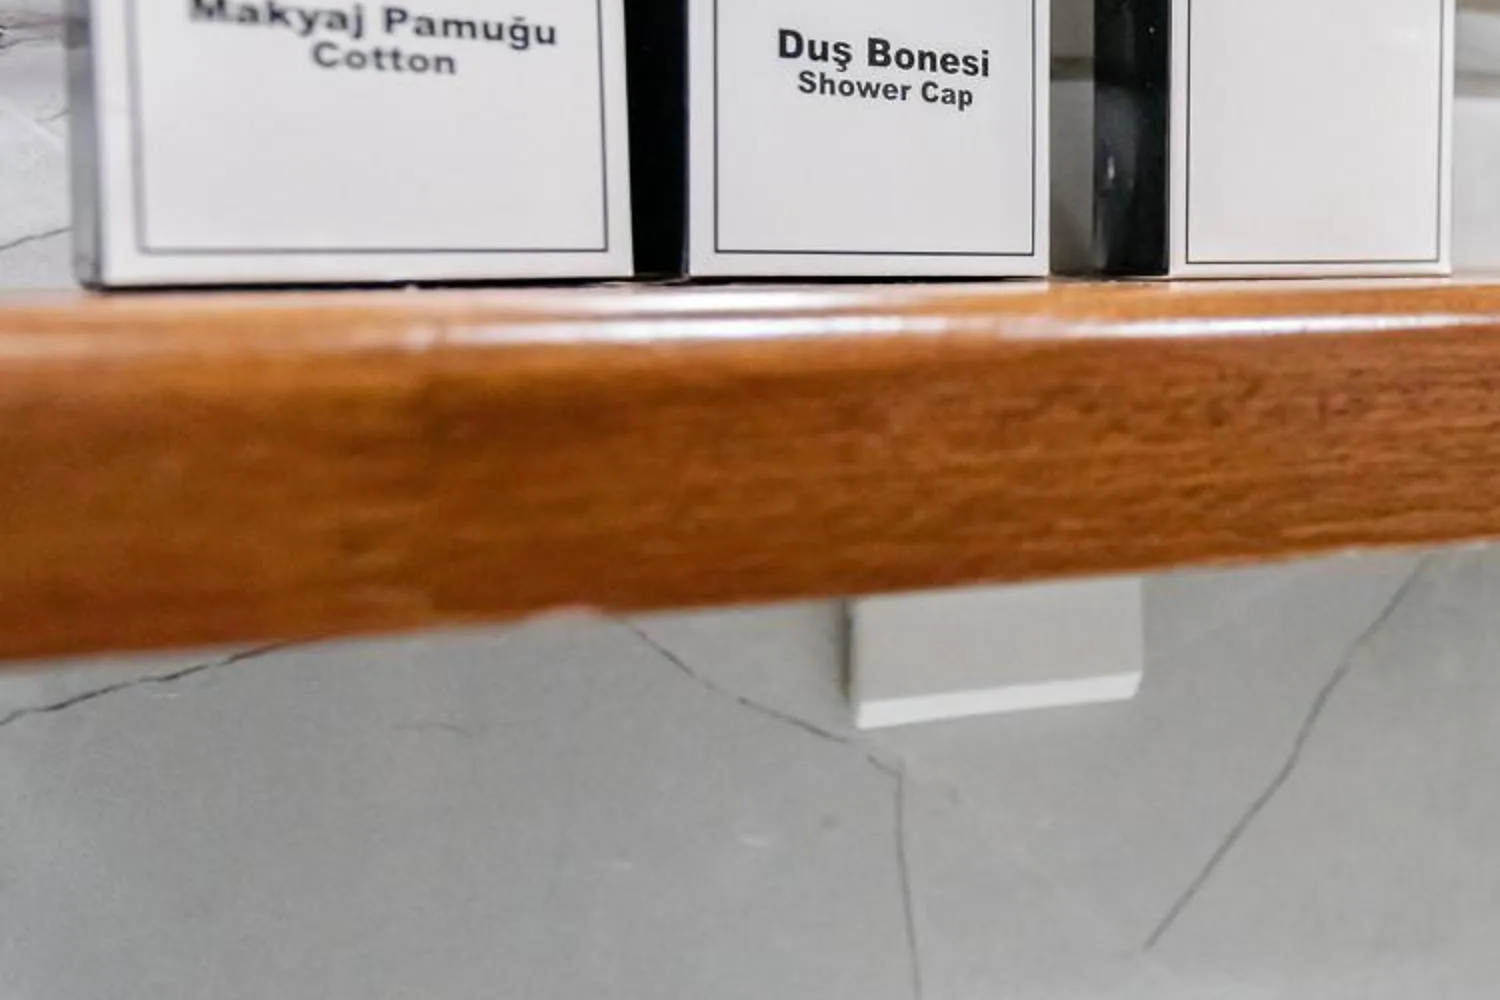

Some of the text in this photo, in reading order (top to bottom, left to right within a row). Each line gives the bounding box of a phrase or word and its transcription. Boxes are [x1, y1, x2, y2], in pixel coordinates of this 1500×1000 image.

[383, 6, 557, 51] Pamuğu
[310, 40, 457, 75] Cotton
[777, 28, 990, 77] Duş Bonesi
[797, 69, 973, 111] Shower Cap
